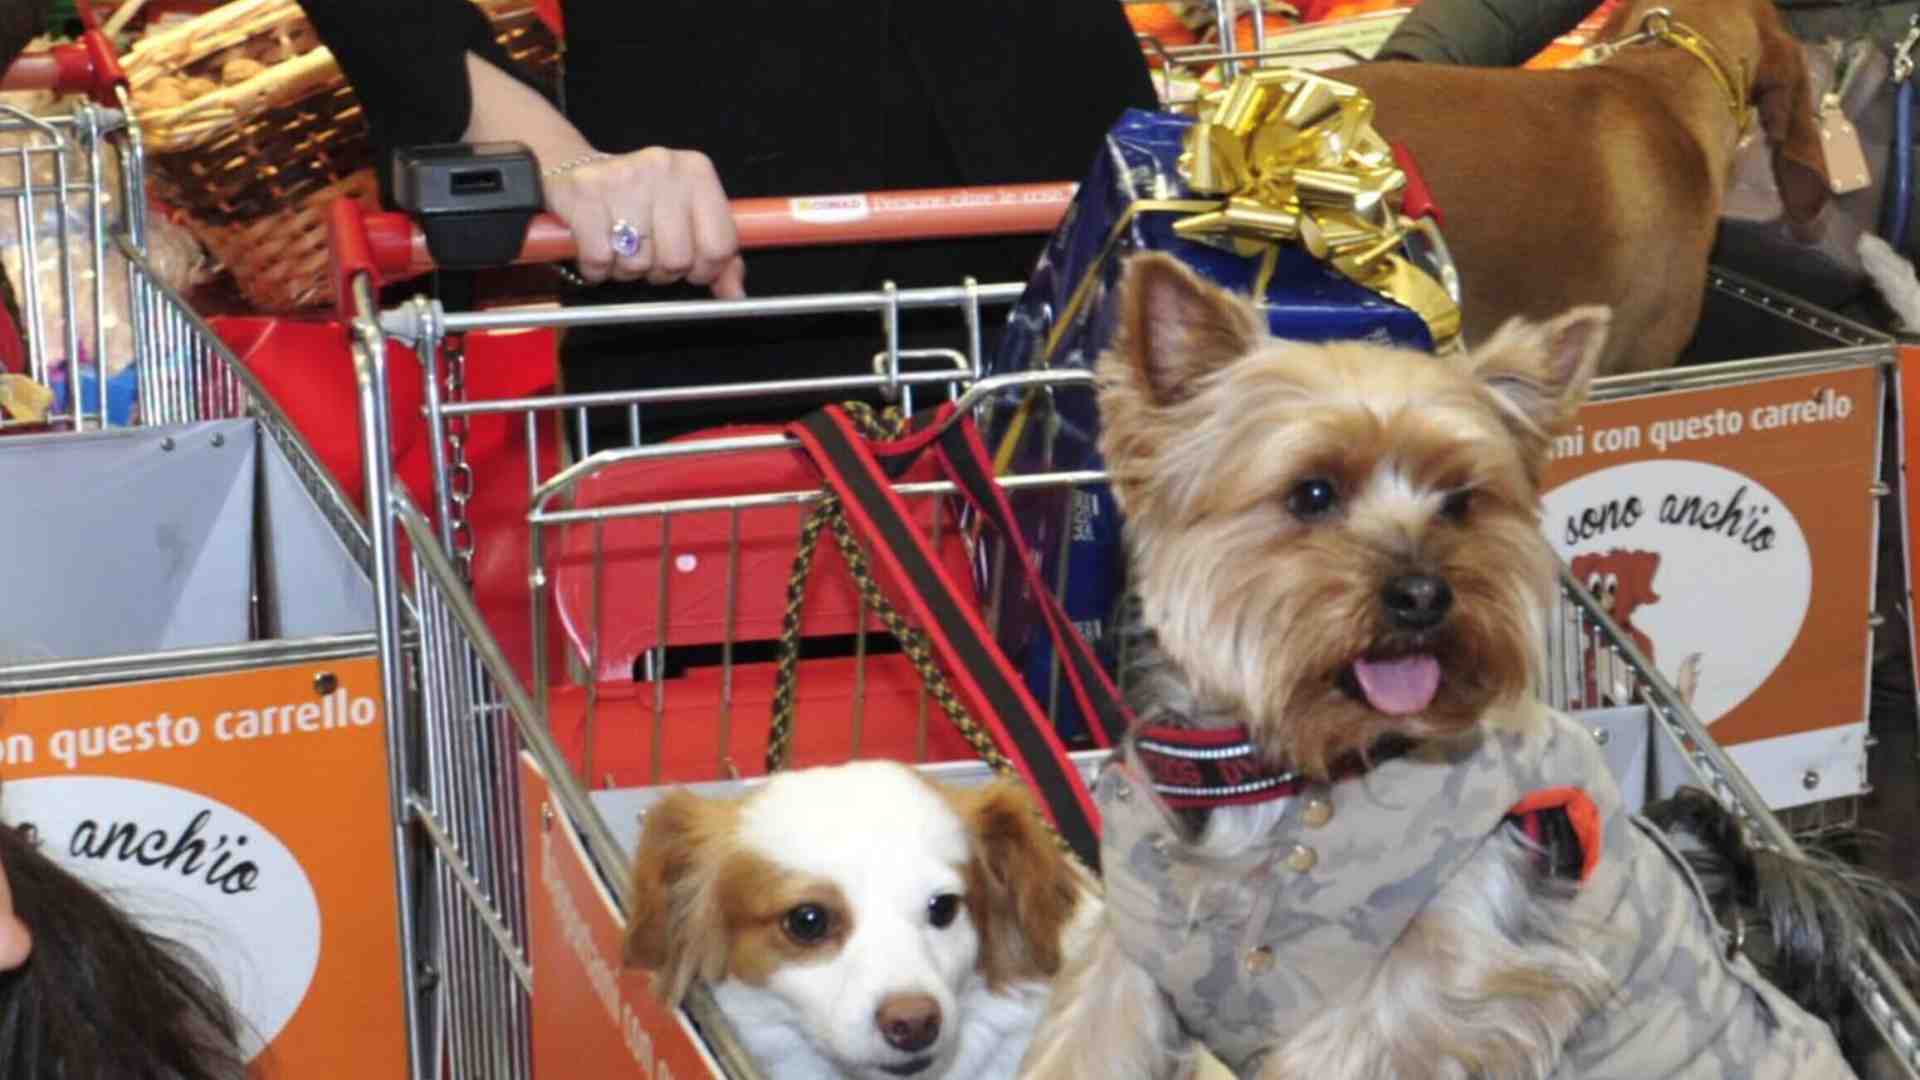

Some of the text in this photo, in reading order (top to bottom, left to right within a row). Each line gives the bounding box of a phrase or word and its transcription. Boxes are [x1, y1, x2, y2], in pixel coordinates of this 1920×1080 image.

[1592, 424, 1641, 454] con
[1650, 408, 1743, 453] questo
[1751, 387, 1851, 431] carrello
[1566, 496, 1643, 546] sono
[49, 713, 200, 769] questo
[214, 687, 376, 742] carrello
[69, 809, 260, 895] anch'io
